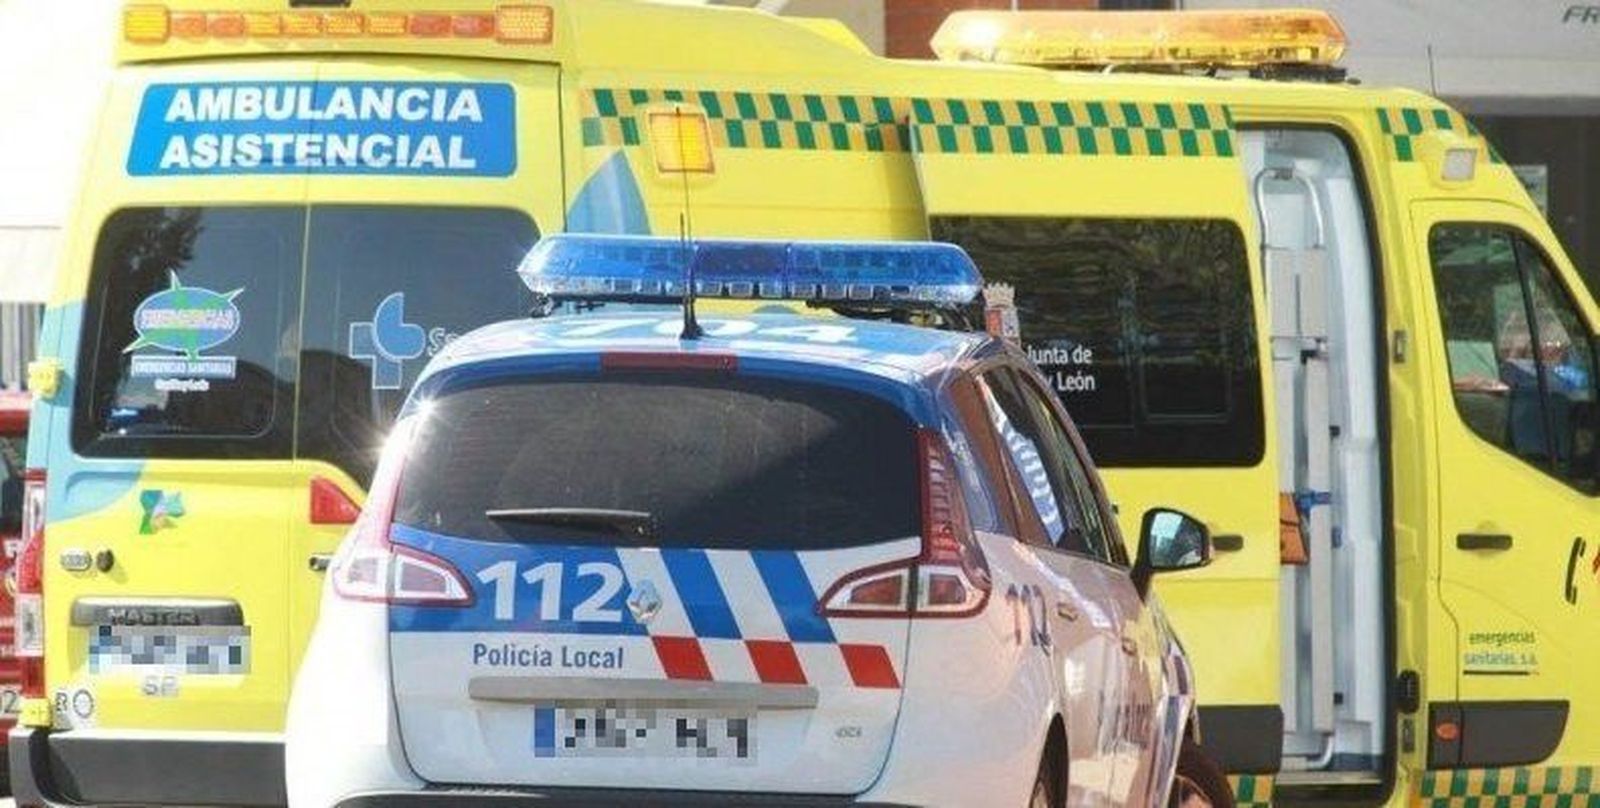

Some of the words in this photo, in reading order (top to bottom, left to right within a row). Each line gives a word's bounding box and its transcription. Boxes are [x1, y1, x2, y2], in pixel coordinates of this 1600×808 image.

[165, 87, 483, 122] AMBULANCIA
[160, 133, 477, 169] ASISTENCIAL
[1072, 344, 1093, 364] de
[1056, 370, 1096, 391] León
[475, 560, 625, 623] 112
[1468, 632, 1536, 647] emergencias
[472, 643, 553, 668] Policía
[561, 643, 624, 670] Local
